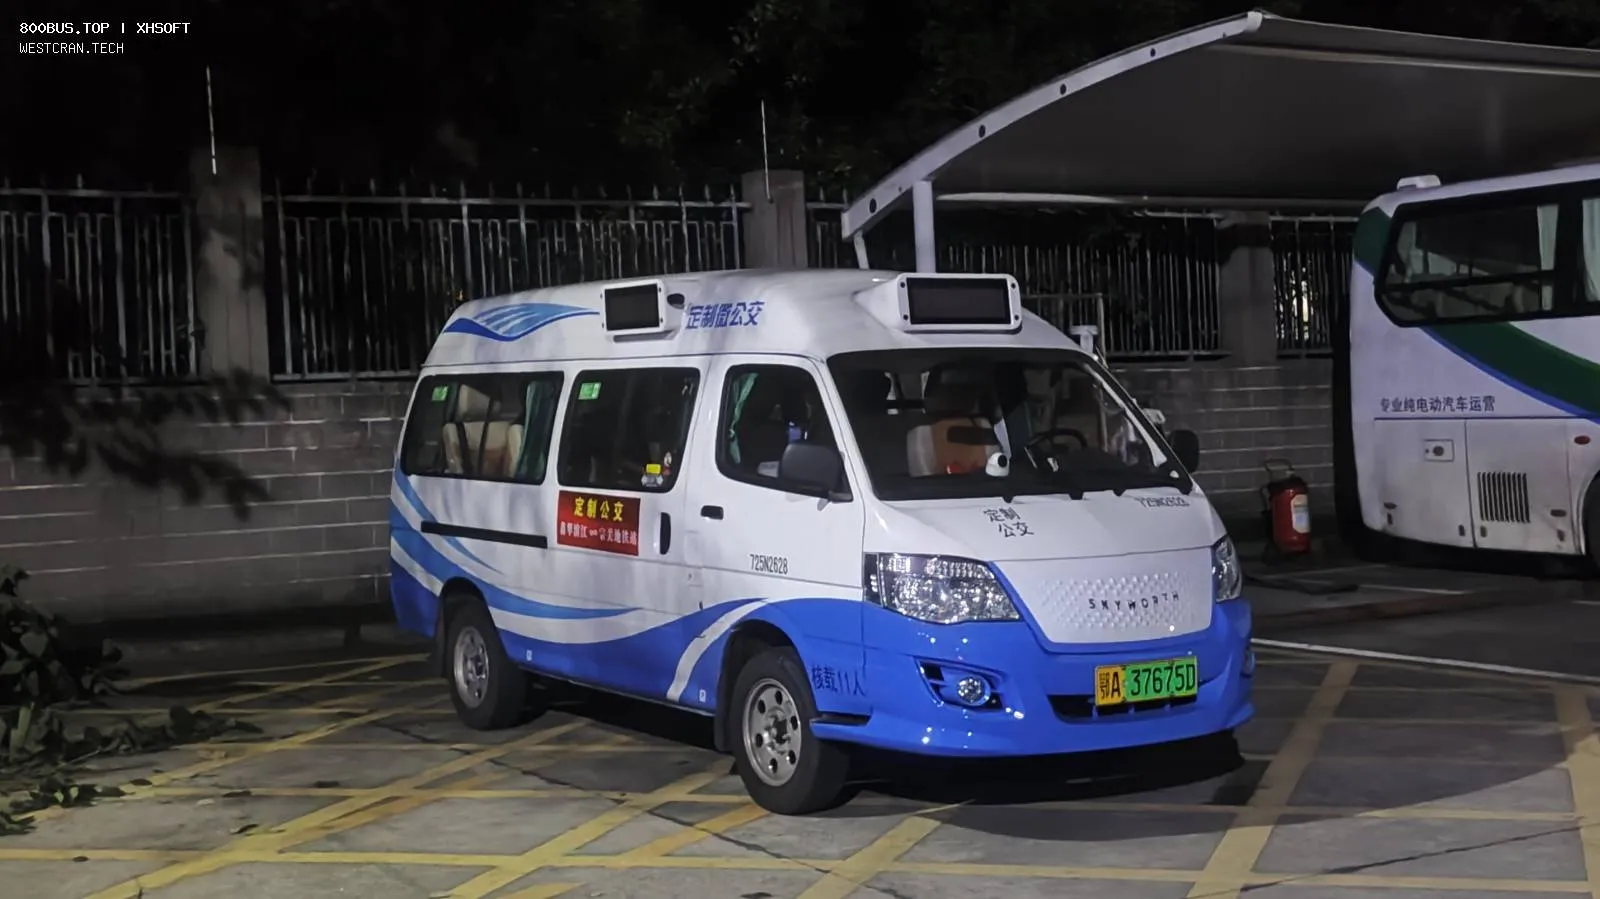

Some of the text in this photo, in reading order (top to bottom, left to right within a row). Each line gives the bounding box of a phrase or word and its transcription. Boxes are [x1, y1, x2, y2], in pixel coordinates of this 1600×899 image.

[685, 300, 766, 330] 定制微公交
[1380, 395, 1496, 413] 专业纯电动汽车运营
[983, 507, 1021, 522] 定制
[998, 521, 1035, 538] 公交
[749, 553, 788, 575] 725N2628
[1088, 591, 1180, 610] SKYWORTH
[1129, 663, 1196, 697] 37675D
